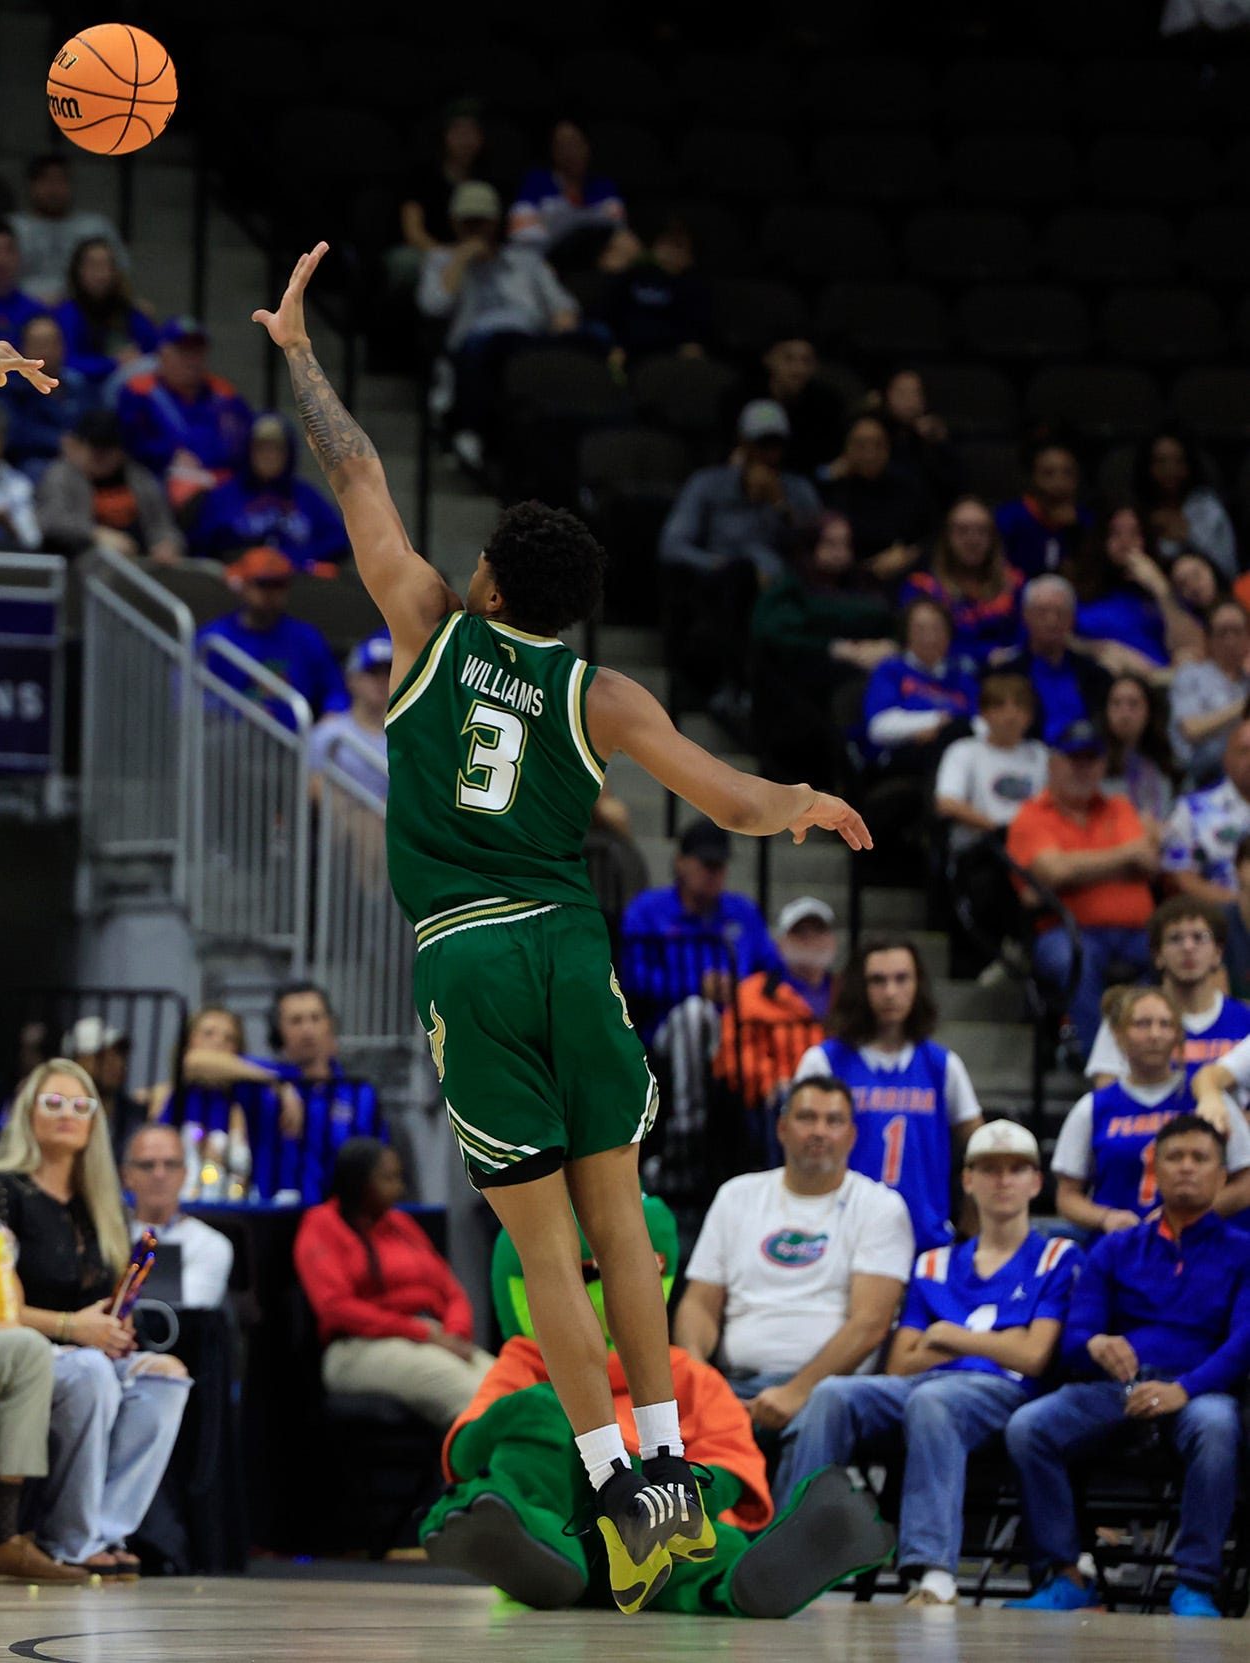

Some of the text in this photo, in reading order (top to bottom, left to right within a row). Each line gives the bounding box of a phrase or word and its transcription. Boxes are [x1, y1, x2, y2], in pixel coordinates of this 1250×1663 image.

[460, 654, 544, 717] WILLIAMS
[455, 699, 529, 816] 3
[882, 1114, 908, 1187] 1
